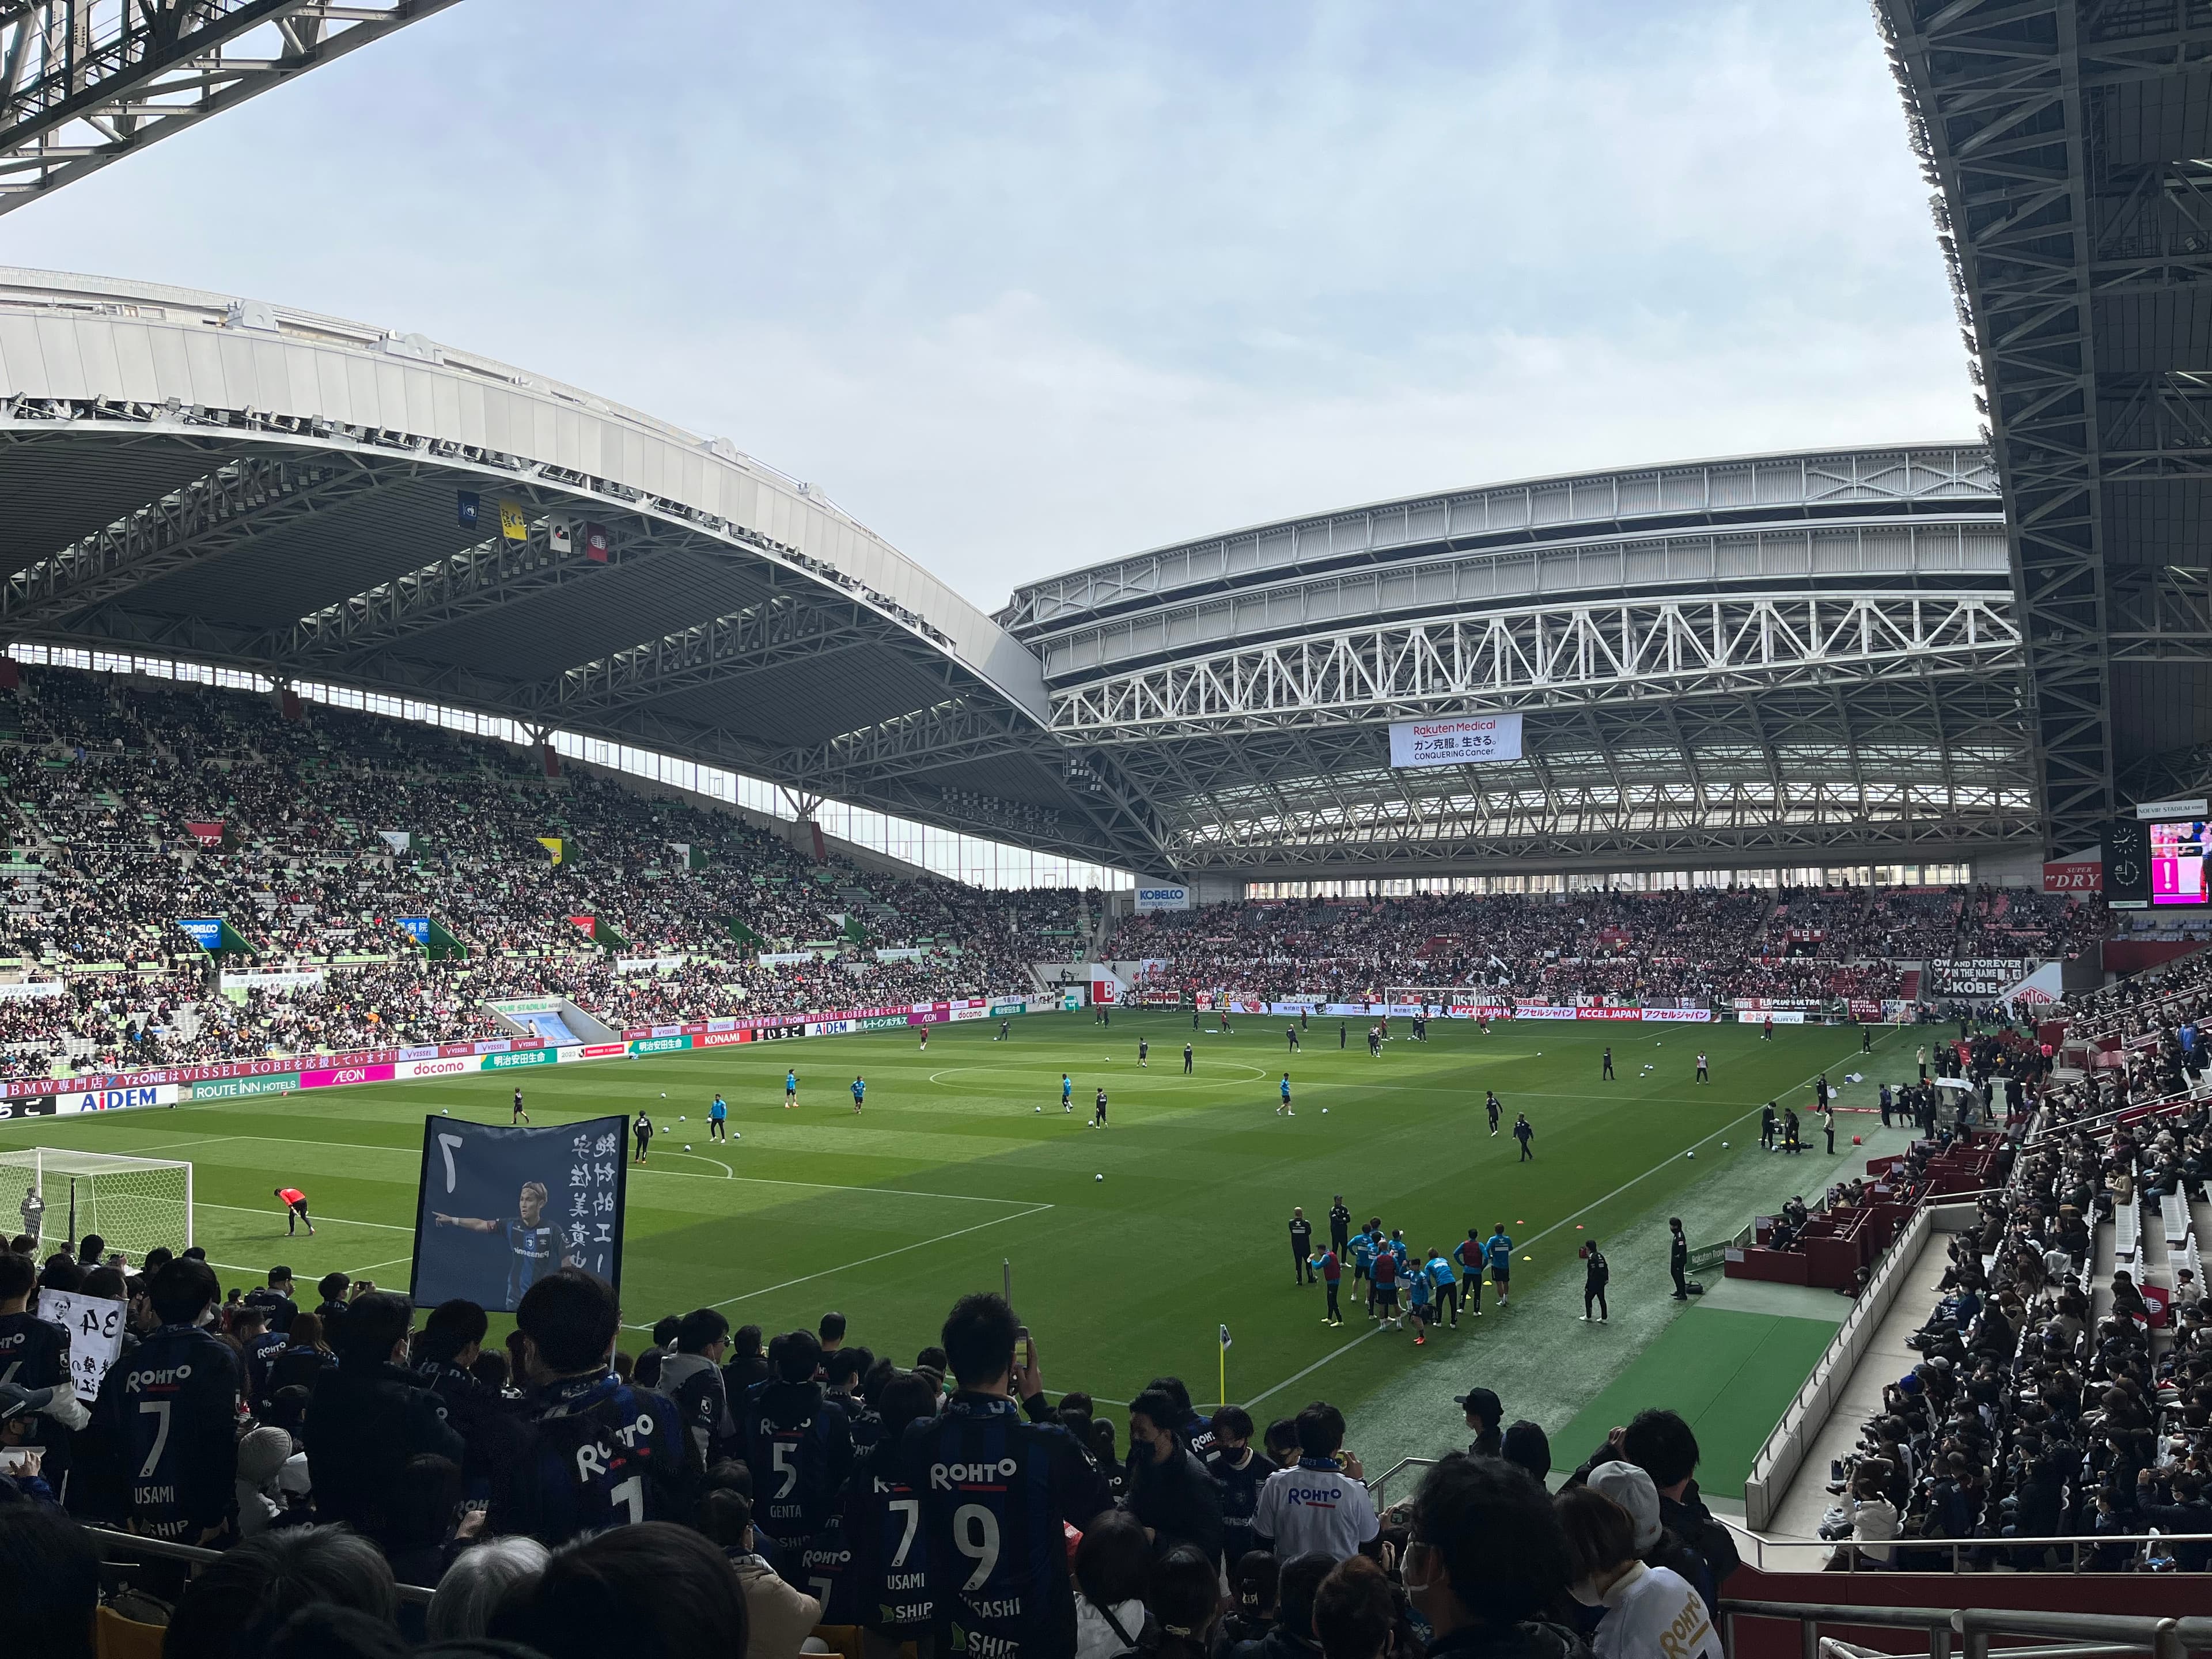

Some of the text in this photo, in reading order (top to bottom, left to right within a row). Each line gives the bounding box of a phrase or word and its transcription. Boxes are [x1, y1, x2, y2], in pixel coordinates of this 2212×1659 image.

[1414, 720, 1496, 736] Rakuten Medical
[1414, 749, 1464, 760] CONQUERING
[1139, 890, 1184, 900] KOBELCO
[1932, 959, 1951, 968] OW
[1972, 959, 2021, 968] FOREVER
[1951, 968, 1997, 978] IN THE NAME
[1952, 982, 1998, 994] KOBE
[958, 1010, 982, 1019] docomo
[1578, 1010, 1639, 1018] ACCEL JAPAN
[1645, 1010, 1708, 1019] アクセルジャパン
[704, 1032, 740, 1046] KONAMI
[767, 1025, 800, 1039] いちご
[639, 1037, 683, 1052] 明治安田生命
[494, 1051, 546, 1066] 明治安田生命
[414, 1060, 464, 1075] docomo
[196, 1082, 237, 1099] ROUTE
[263, 1080, 296, 1092] HOTELS
[1691, 1252, 1712, 1264] Rakuten
[257, 1342, 286, 1359] ROHTO
[126, 1365, 192, 1393] ROHTO
[138, 1400, 171, 1478] 7
[772, 1442, 798, 1499] 5
[930, 1458, 1017, 1491] ROHTO
[134, 1486, 174, 1505] USAMI
[1288, 1488, 1342, 1506] ROHTO
[770, 1505, 802, 1518] GENTA
[889, 1499, 919, 1567] 7
[953, 1503, 1000, 1591] 9
[802, 1550, 851, 1568] ROHTO
[887, 1573, 925, 1590] USAMI
[808, 1575, 833, 1626] 7
[895, 1601, 934, 1619] SHIP
[1659, 1590, 1702, 1659] ROHTO
